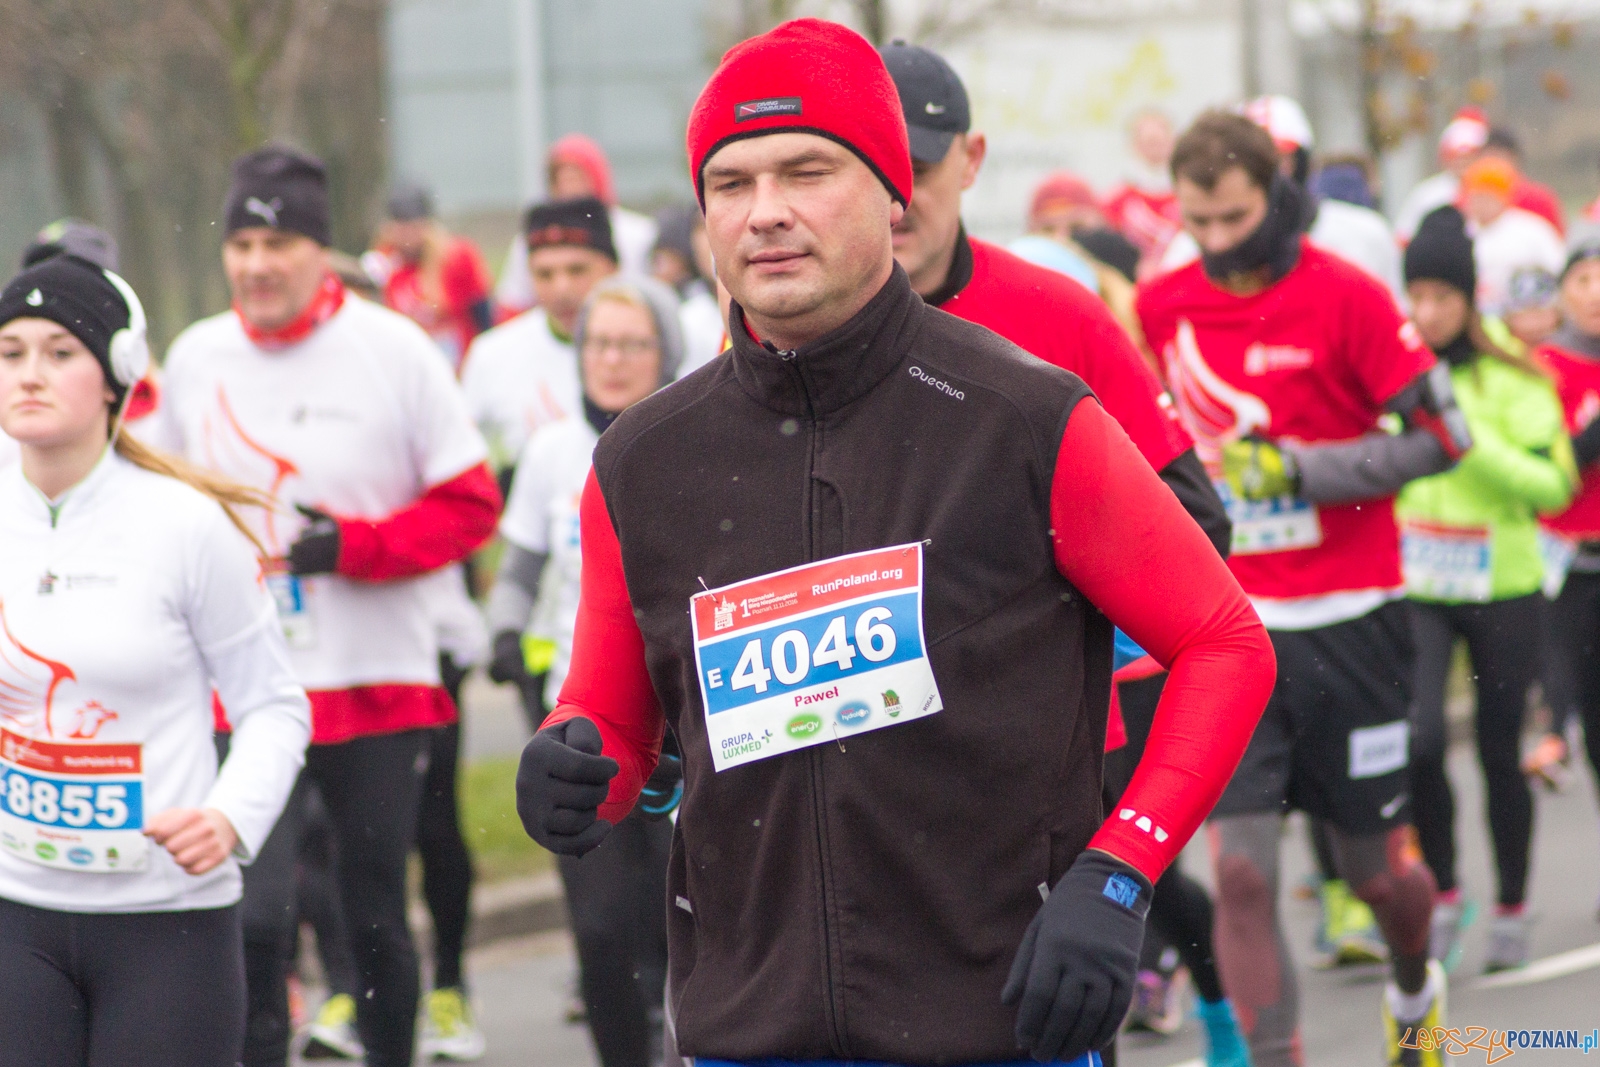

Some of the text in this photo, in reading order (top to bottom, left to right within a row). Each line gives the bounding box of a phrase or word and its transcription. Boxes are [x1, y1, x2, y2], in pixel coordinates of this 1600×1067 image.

[909, 366, 965, 400] Quechua
[812, 568, 903, 596] RunPoland.org
[740, 599, 751, 618] 1
[707, 606, 897, 694] E 4046
[794, 686, 839, 707] Paweł
[791, 721, 819, 733] energy
[721, 732, 754, 749] GRUPA
[723, 740, 762, 760] LUXMED
[7, 773, 129, 828] 8855
